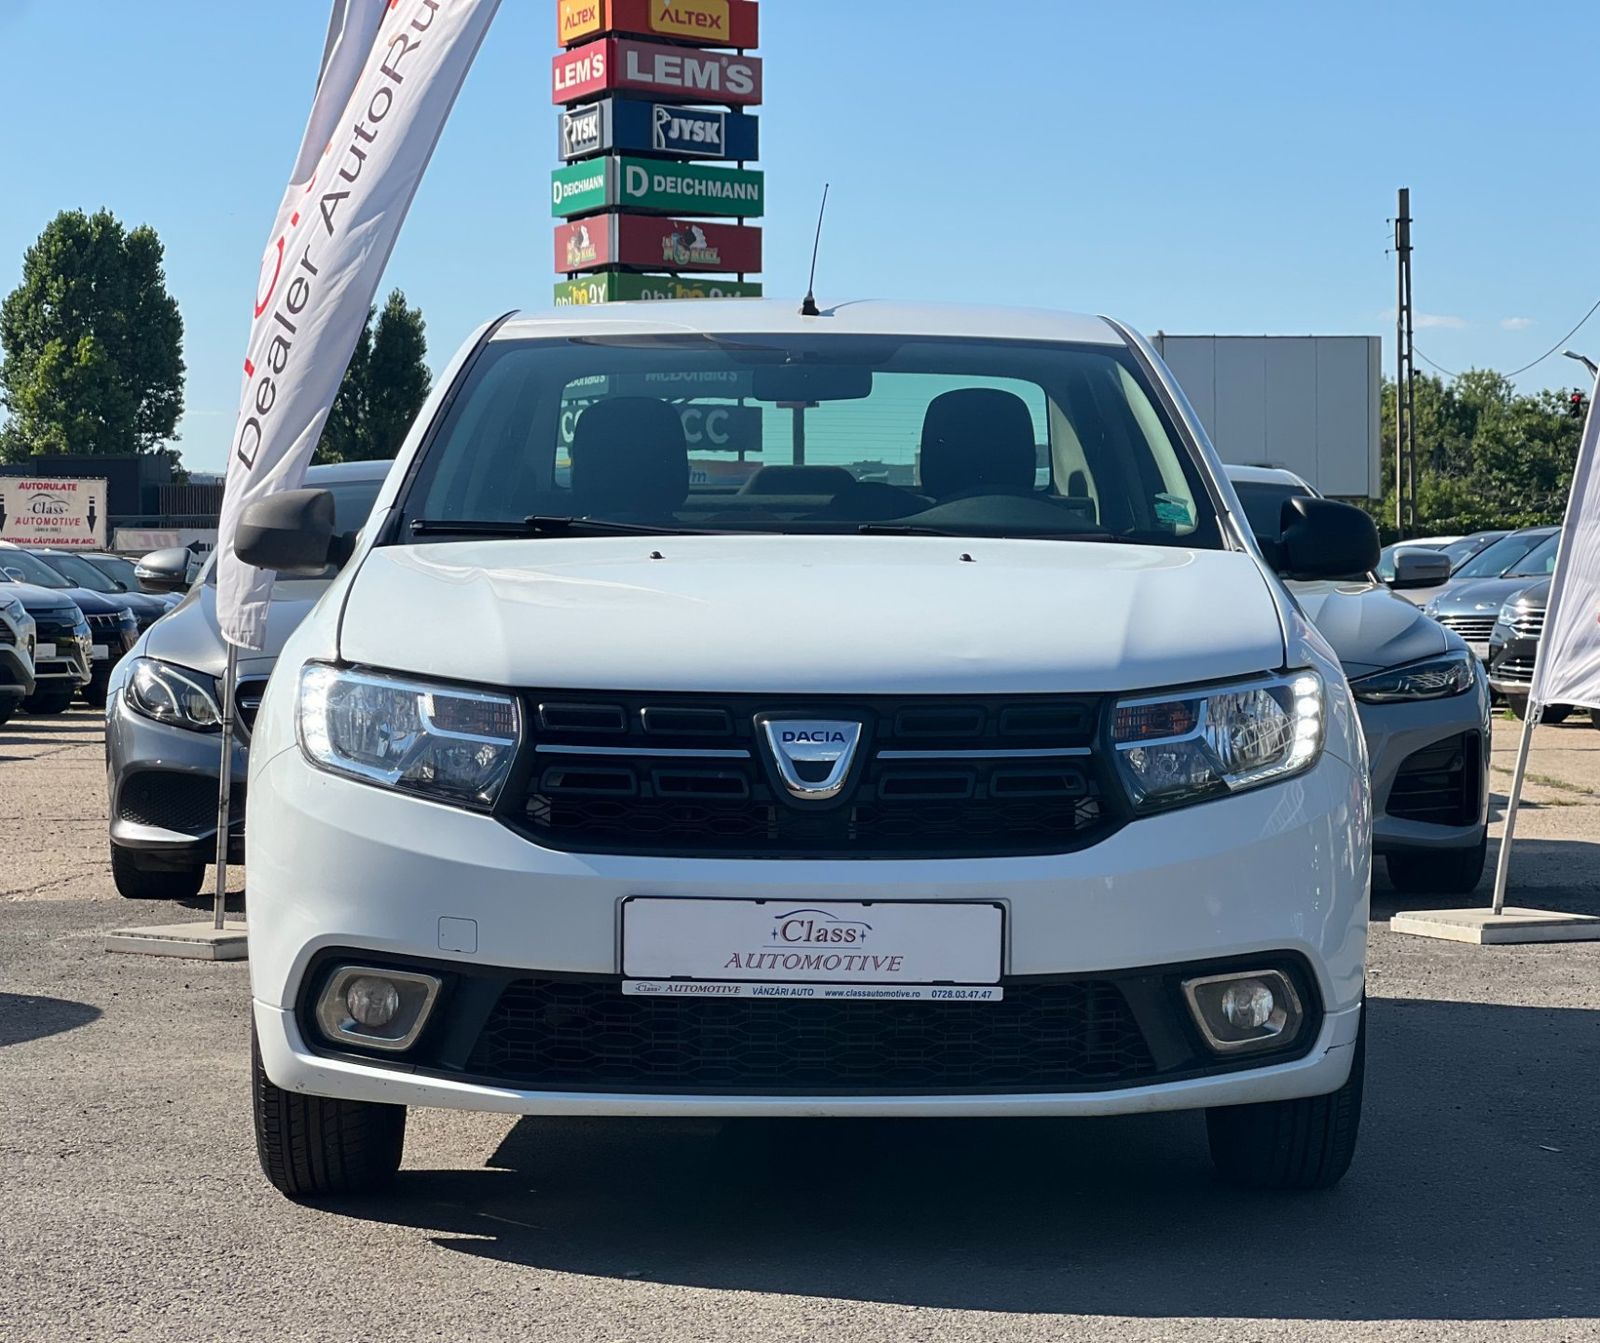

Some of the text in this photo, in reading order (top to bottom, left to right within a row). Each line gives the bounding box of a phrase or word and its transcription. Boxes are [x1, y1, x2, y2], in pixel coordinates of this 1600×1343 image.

[555, 51, 604, 91] LEM'S
[626, 50, 754, 95] LEM'S
[571, 115, 597, 143] JYSK
[668, 117, 720, 144] JYSK
[563, 174, 604, 197] DEICHMANN
[653, 175, 759, 200] DEICHMANN
[237, 0, 440, 471] Dealer AutoRu
[681, 408, 729, 444] CC
[18, 482, 78, 492] AUTORULATE
[32, 502, 64, 515] Class
[14, 516, 81, 526] AUTOMOTIVE
[782, 731, 846, 743] DACIA
[780, 919, 857, 943] Class
[724, 952, 904, 972] AUTOMOTIVE
[666, 984, 742, 994] AUTOMOTIVE
[791, 988, 814, 996] AUTO
[825, 988, 921, 998] www.classautomotive.ro
[931, 990, 993, 999] 0728.03.47.47
